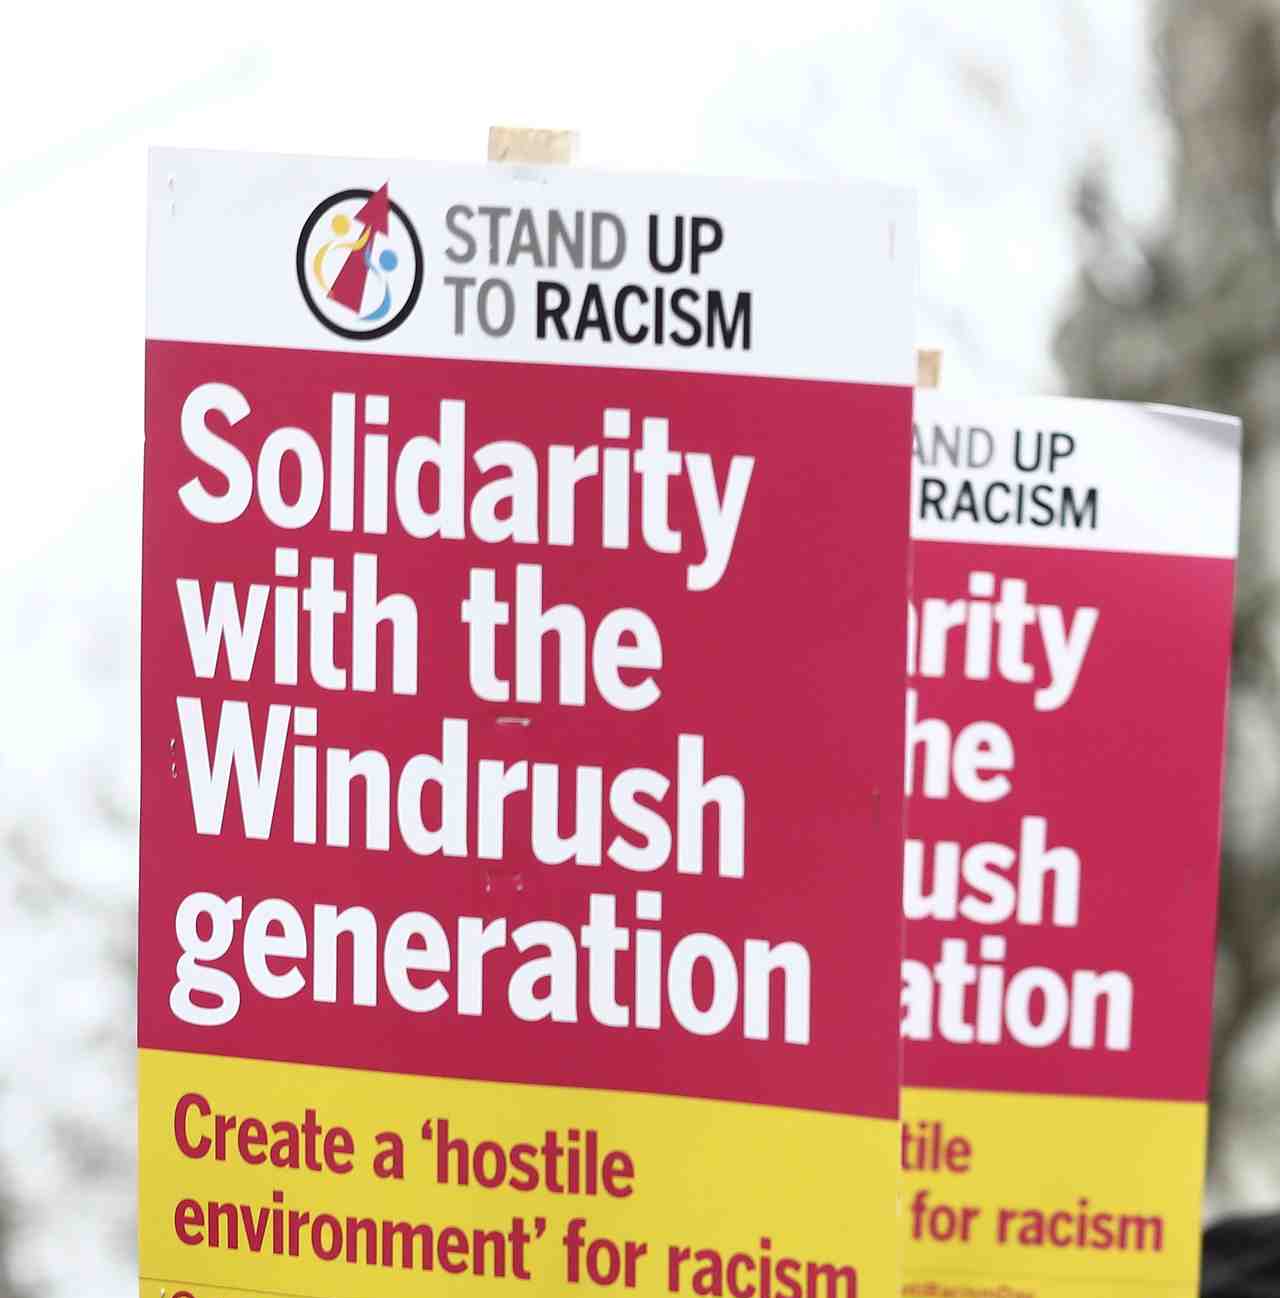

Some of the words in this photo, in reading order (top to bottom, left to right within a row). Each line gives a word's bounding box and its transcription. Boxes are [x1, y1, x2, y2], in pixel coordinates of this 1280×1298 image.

[445, 205, 626, 270] STAND
[649, 214, 723, 274] UP
[444, 276, 515, 338] TO
[537, 281, 751, 350] RACISM
[178, 383, 754, 591] Solidarity
[1014, 430, 1075, 473] UP
[920, 478, 1097, 528] RACISM
[176, 548, 417, 695] with
[461, 564, 662, 710] the
[907, 572, 1098, 710] rity
[177, 696, 744, 878] Windrush
[903, 817, 1080, 926] ush
[170, 891, 810, 1044] generation
[900, 936, 1132, 1050] ation
[174, 1093, 354, 1174] Create
[373, 1132, 404, 1179] a
[563, 1218, 647, 1288] for
[911, 1190, 980, 1242] for
[997, 1198, 1164, 1252] racism
